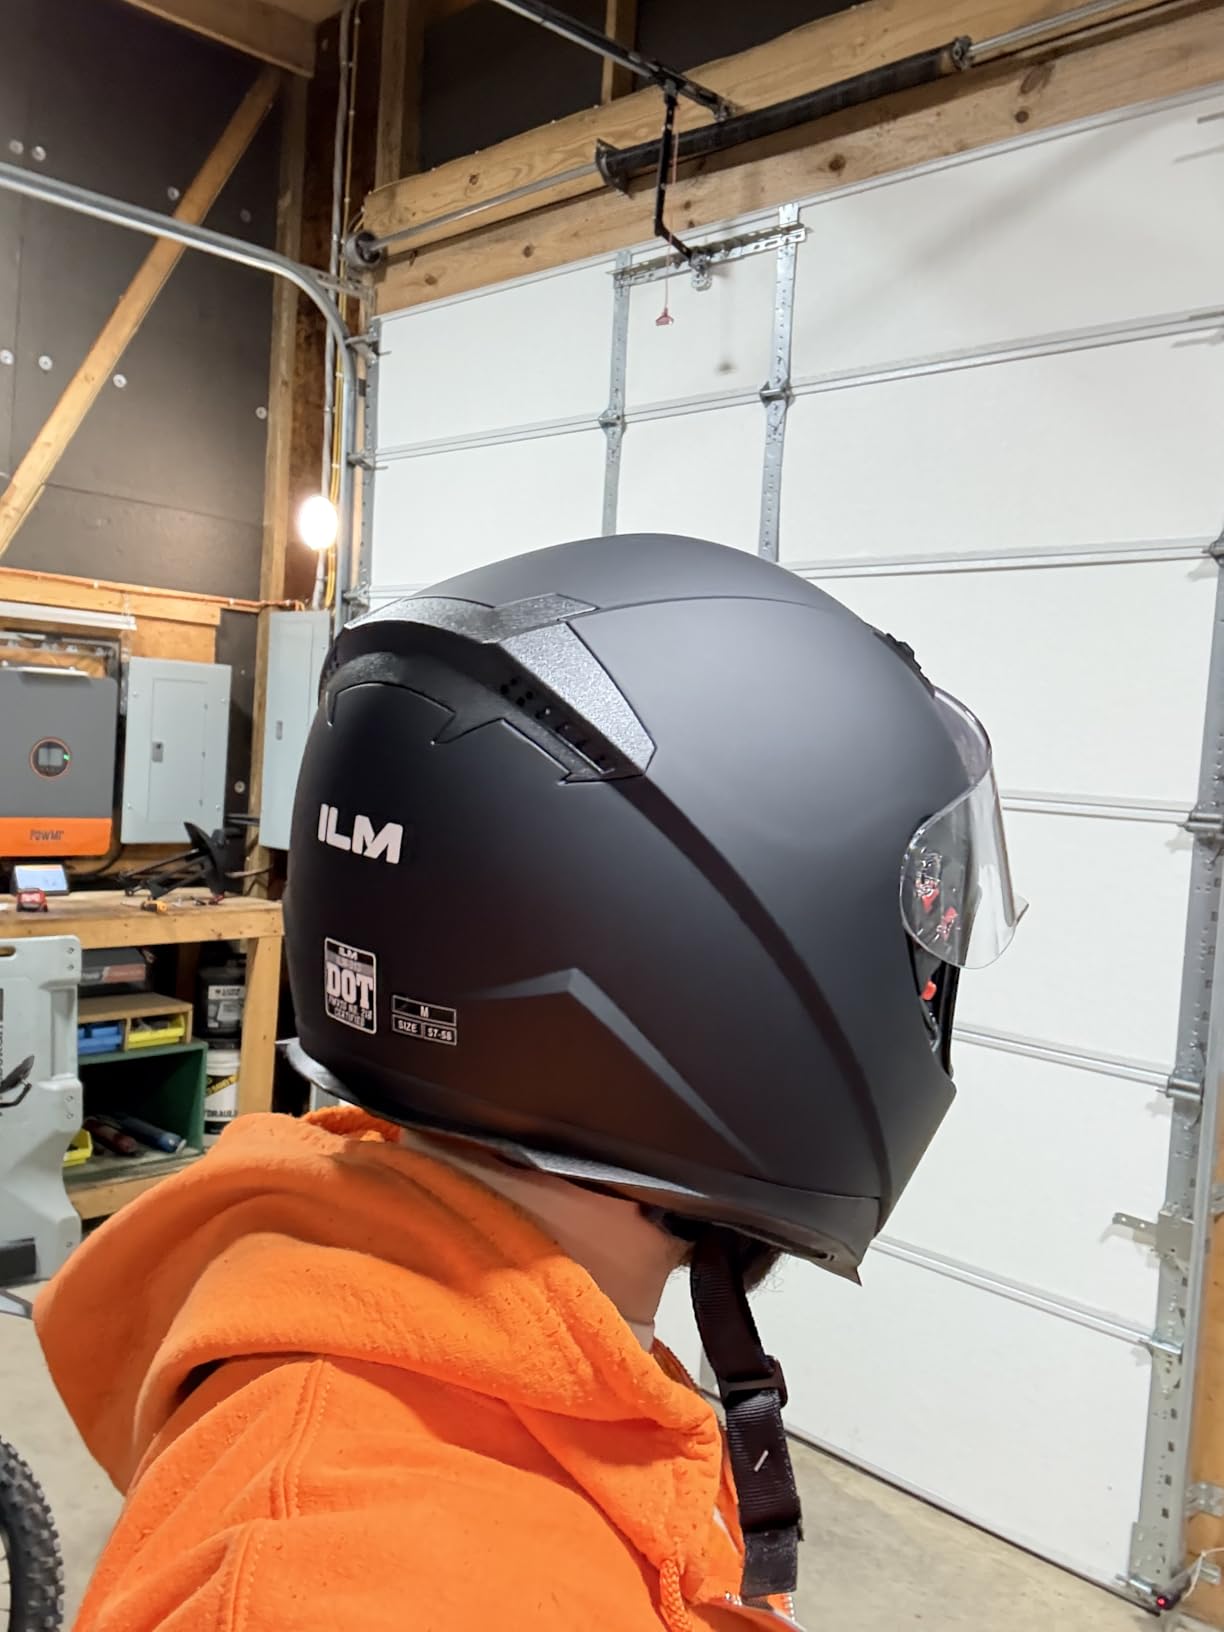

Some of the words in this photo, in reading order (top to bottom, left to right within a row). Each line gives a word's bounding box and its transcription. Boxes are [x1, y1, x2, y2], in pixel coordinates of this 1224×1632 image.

[318, 803, 404, 865] ILM
[327, 961, 374, 1010] DOT
[398, 1020, 418, 1033] SIZE
[420, 1005, 430, 1018] M
